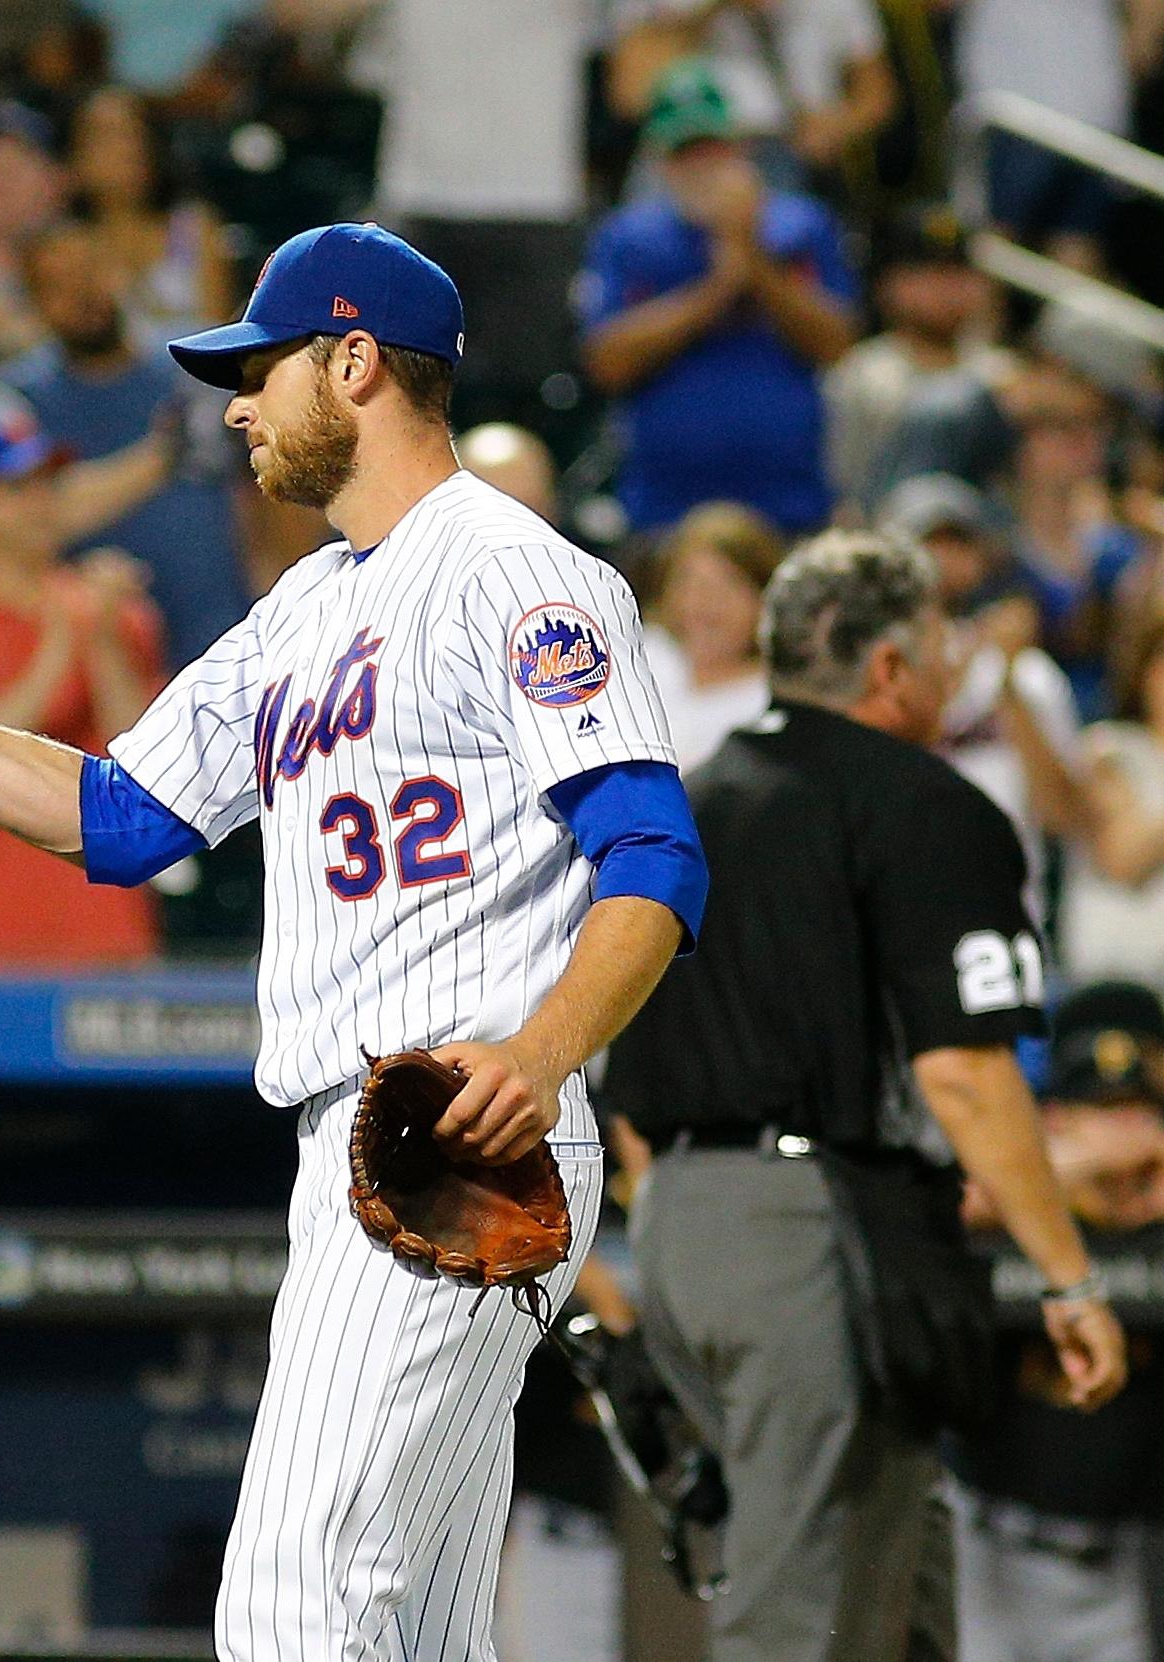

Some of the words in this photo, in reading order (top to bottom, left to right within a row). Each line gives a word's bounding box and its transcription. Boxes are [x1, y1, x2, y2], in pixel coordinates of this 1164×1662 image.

[528, 639, 596, 686] Mets
[319, 775, 471, 901] 32
[953, 929, 1043, 1016] 21
